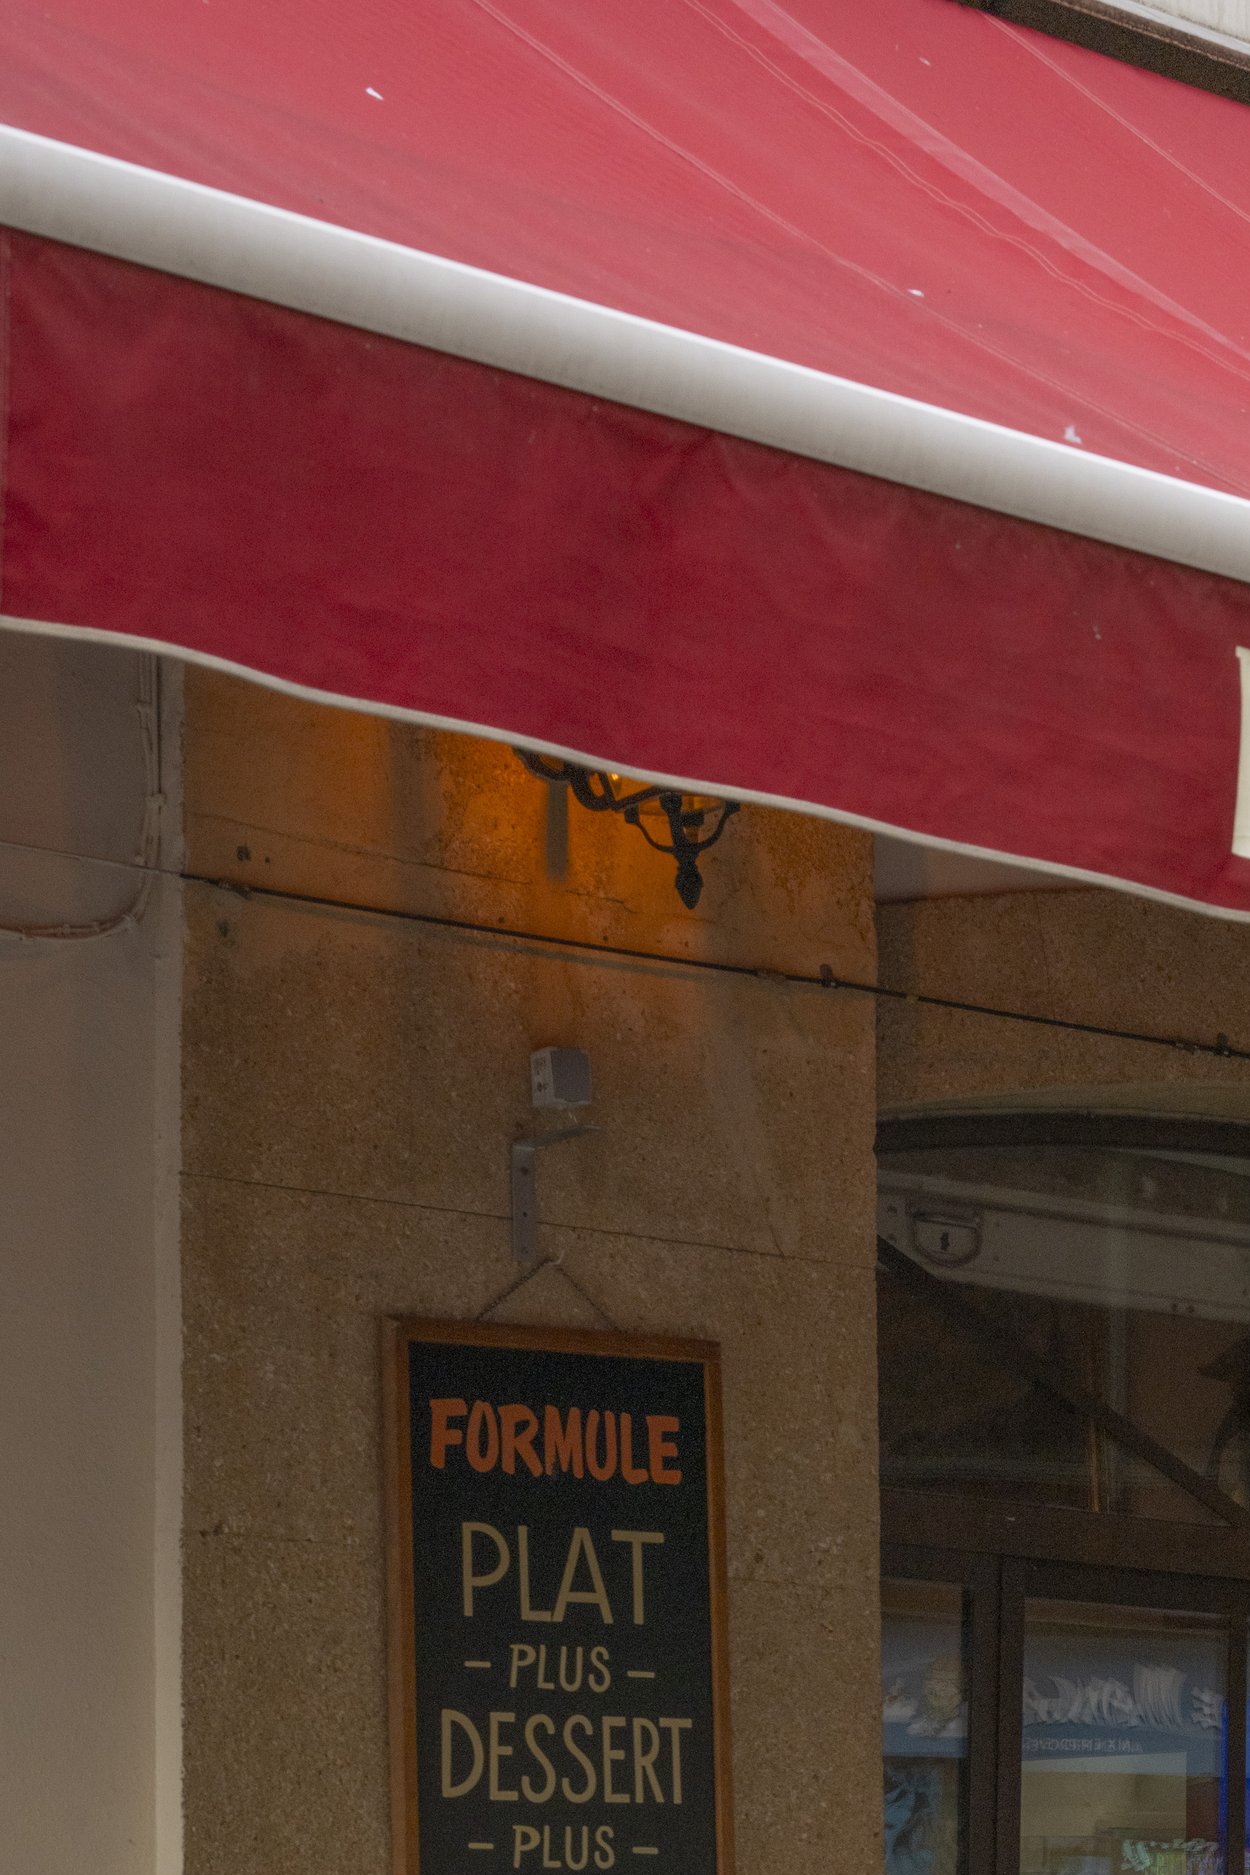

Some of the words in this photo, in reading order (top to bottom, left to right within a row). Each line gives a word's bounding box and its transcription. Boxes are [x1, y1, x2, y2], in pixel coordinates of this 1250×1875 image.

[429, 1398, 683, 1485] FORMULE
[462, 1521, 664, 1625] PLAT
[510, 1644, 611, 1693] PLUS
[440, 1709, 693, 1805] DESSERT
[512, 1824, 615, 1870] PLUS
